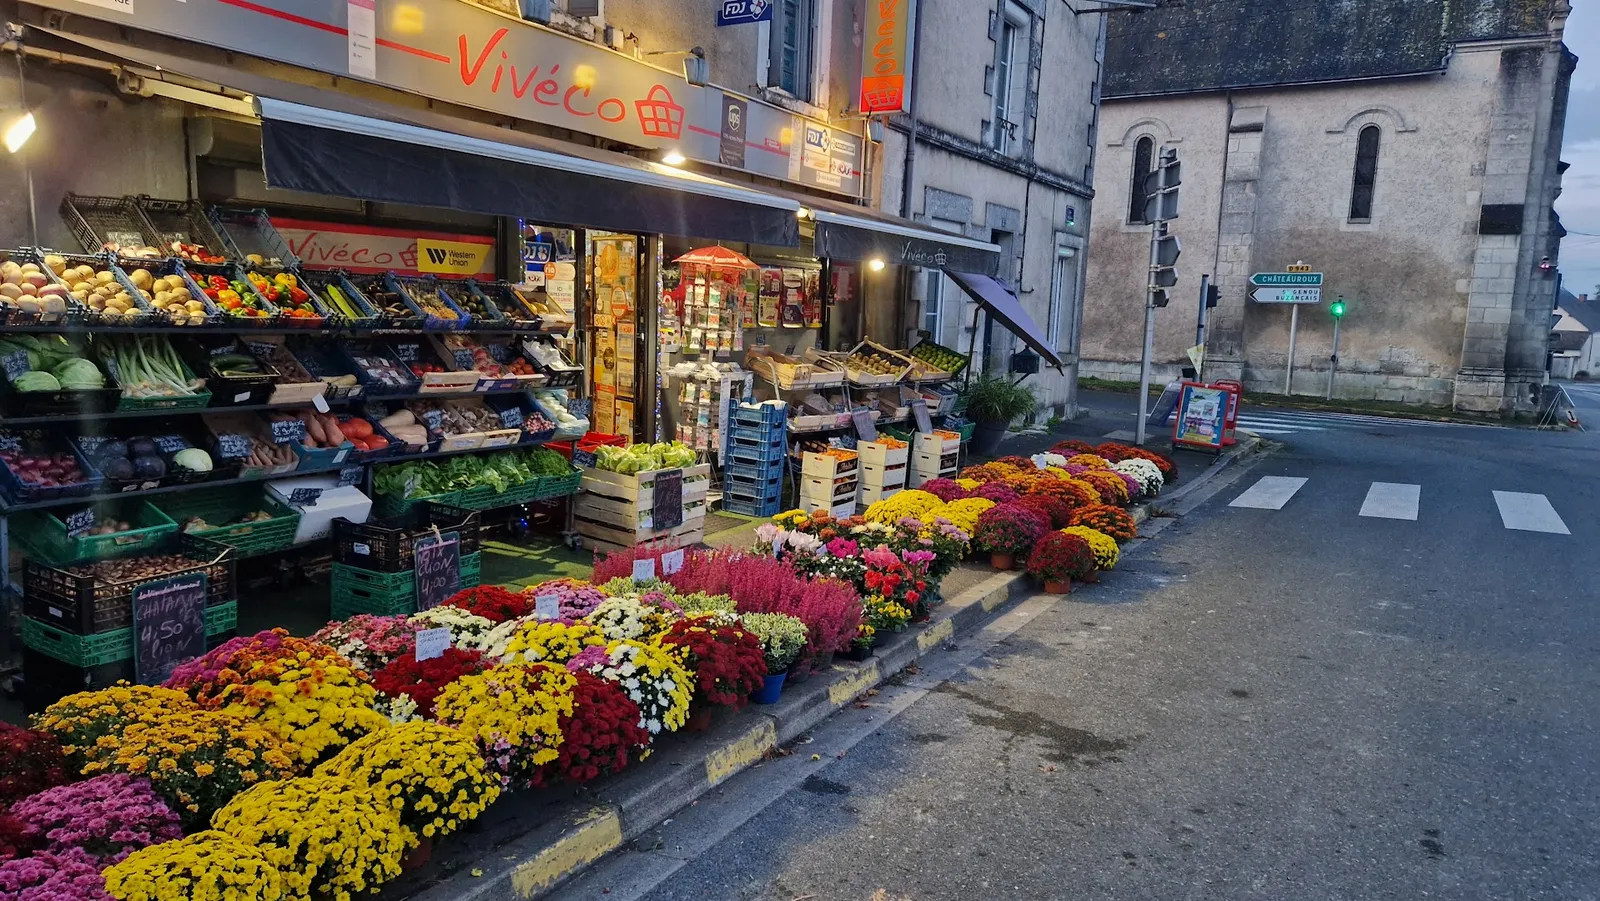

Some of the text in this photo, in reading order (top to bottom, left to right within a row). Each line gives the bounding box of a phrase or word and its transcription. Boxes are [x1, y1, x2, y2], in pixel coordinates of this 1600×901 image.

[725, 2, 746, 15] FDJ
[808, 130, 820, 144] FDJ
[288, 232, 393, 265] Vivéco
[448, 250, 476, 260] Western
[523, 245, 536, 259] DJ
[901, 240, 935, 264] Vivéco
[448, 257, 469, 267] Union
[1262, 275, 1318, 283] CHÂTEAUROUX
[141, 619, 183, 641] 4,50
